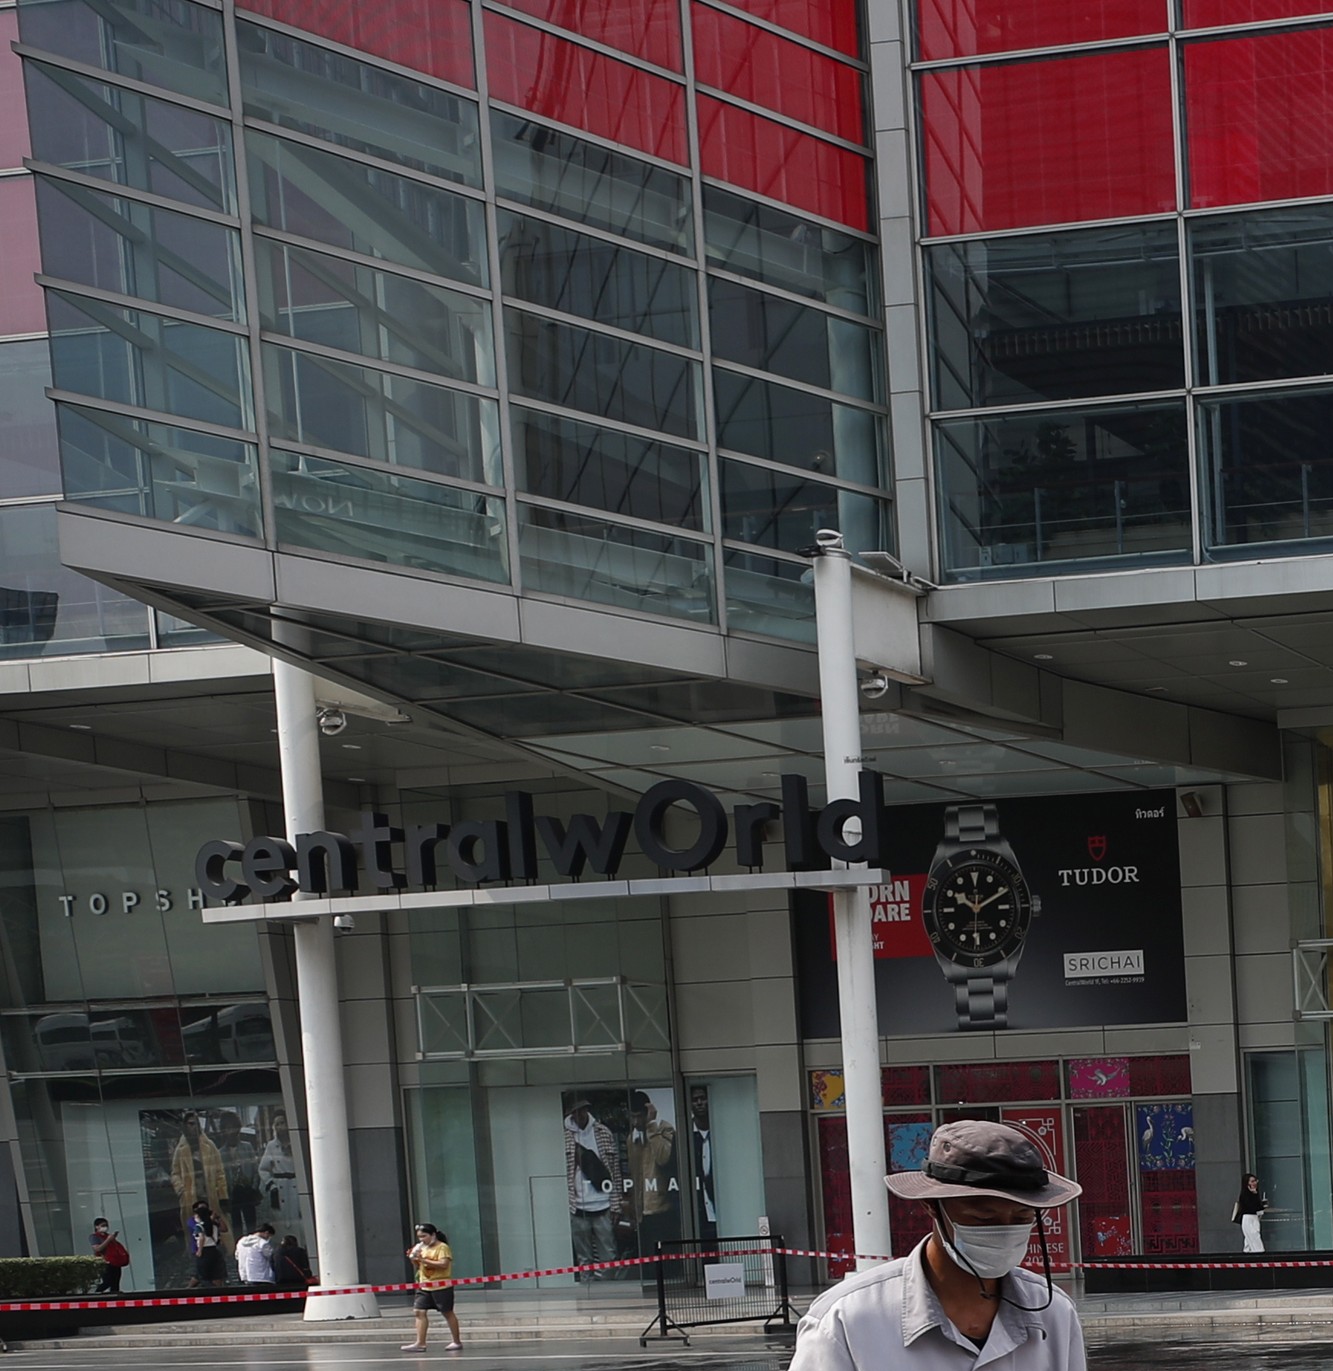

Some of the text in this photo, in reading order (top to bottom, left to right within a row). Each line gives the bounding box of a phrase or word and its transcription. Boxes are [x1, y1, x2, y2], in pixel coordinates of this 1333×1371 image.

[195, 771, 883, 901] centralwOrld
[1058, 866, 1140, 886] TUDOR
[1068, 955, 1140, 971] SRICHAI
